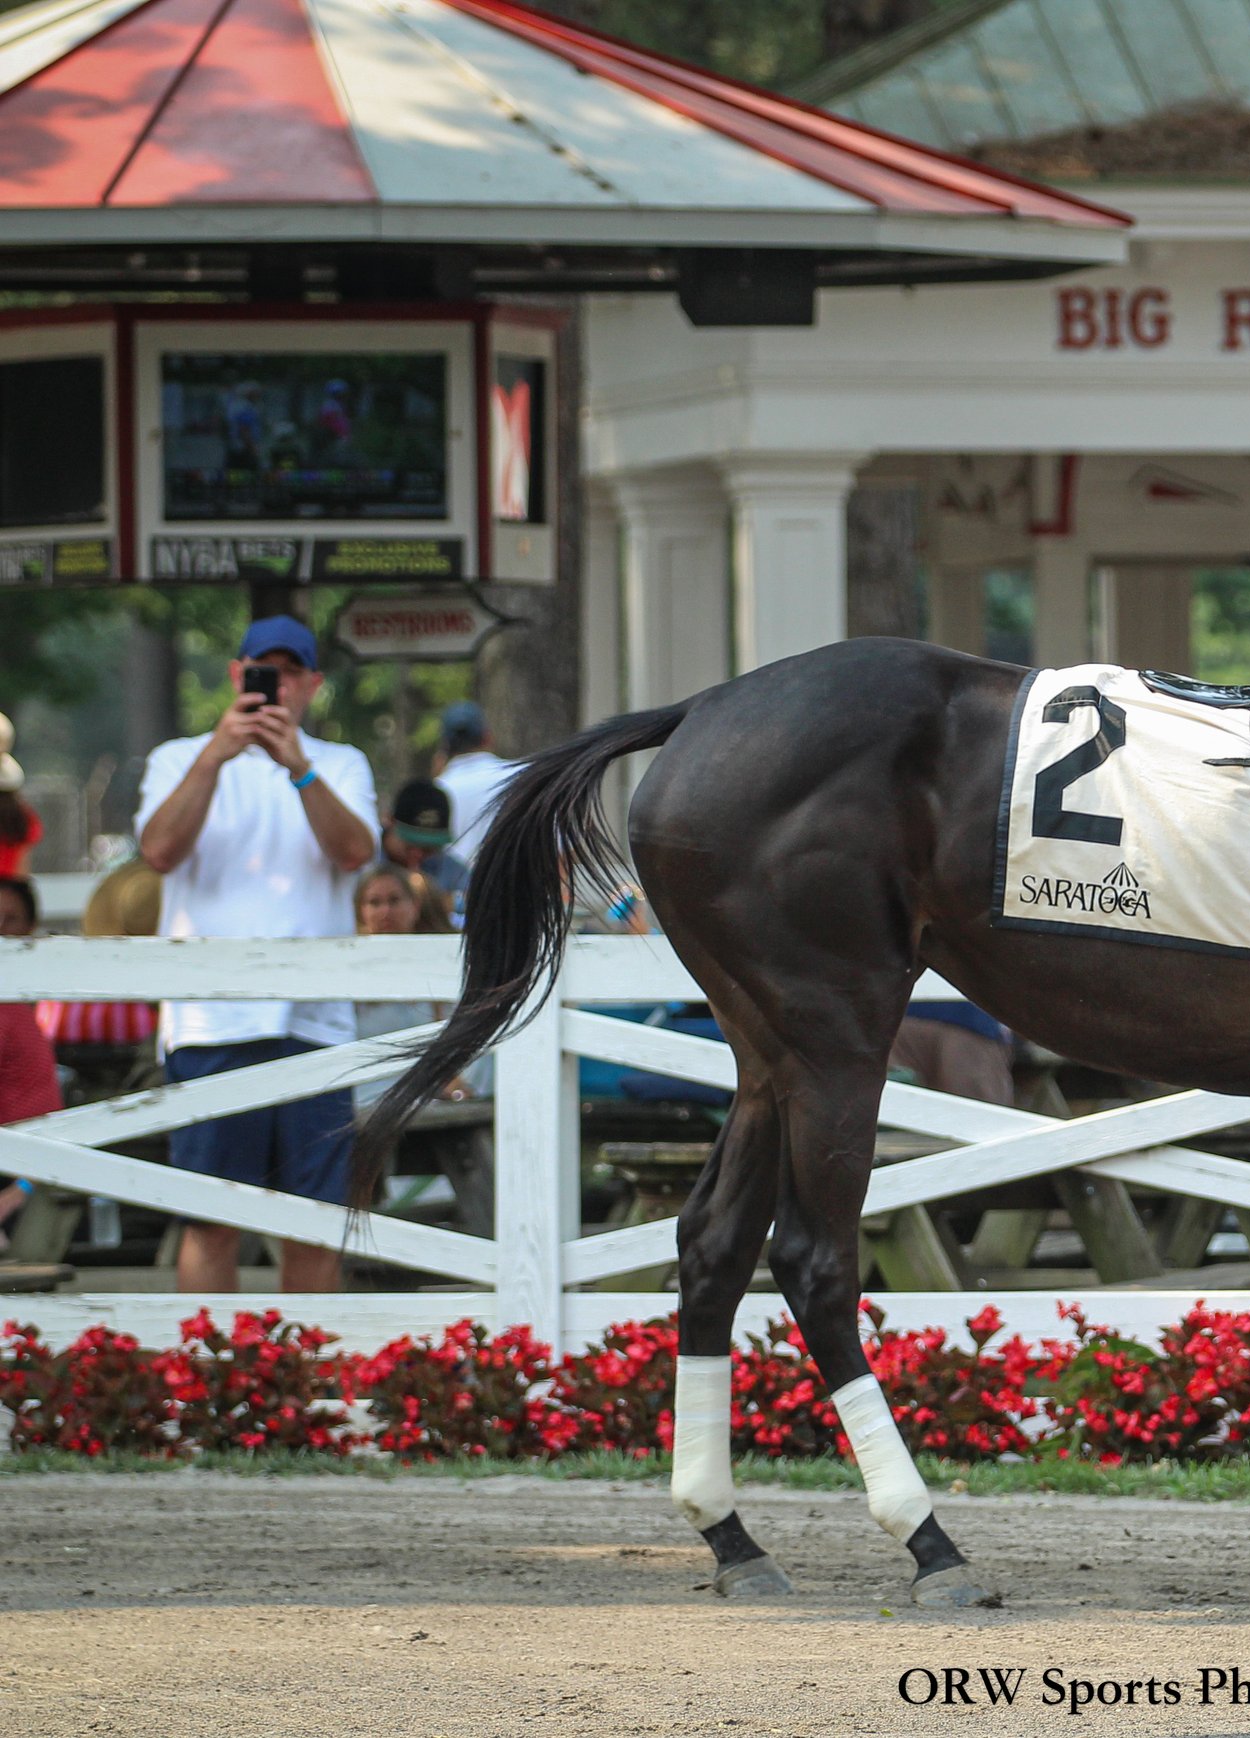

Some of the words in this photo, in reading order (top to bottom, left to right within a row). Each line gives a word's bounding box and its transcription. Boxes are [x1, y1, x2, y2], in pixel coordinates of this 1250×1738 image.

[1056, 288, 1171, 350] BIG
[1032, 685, 1126, 846] 2
[1019, 875, 1152, 919] SARATOGA
